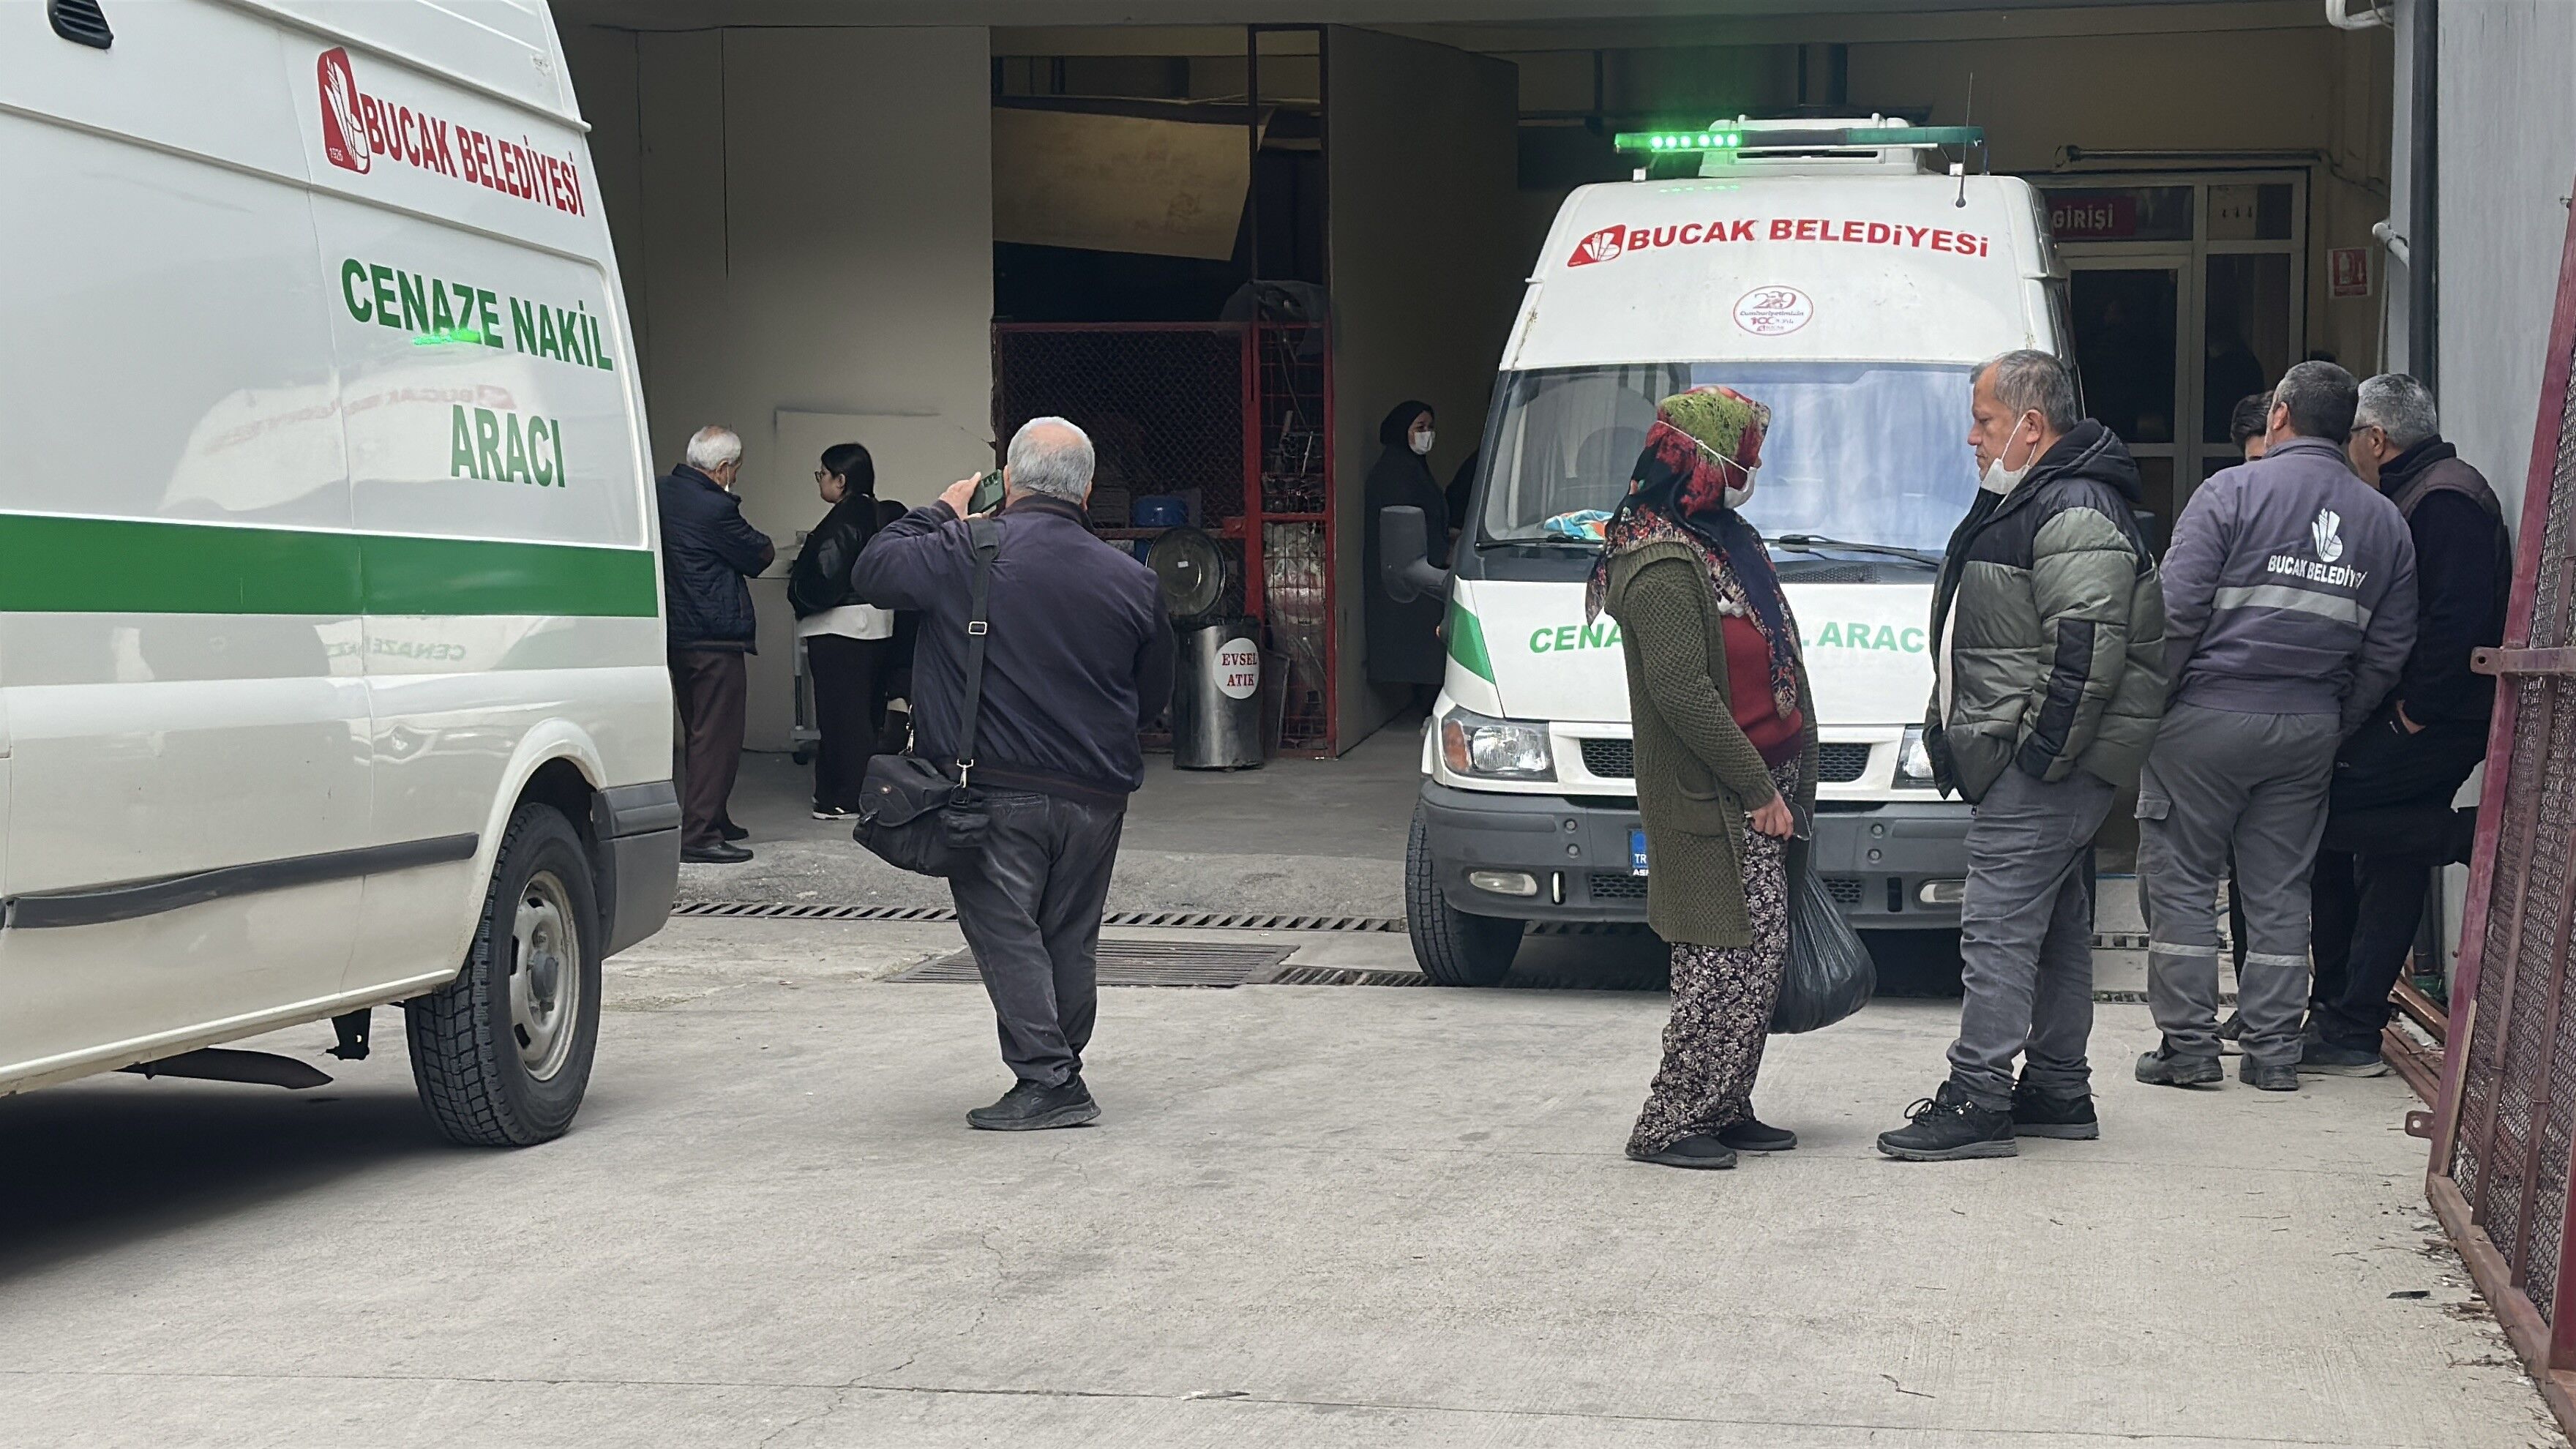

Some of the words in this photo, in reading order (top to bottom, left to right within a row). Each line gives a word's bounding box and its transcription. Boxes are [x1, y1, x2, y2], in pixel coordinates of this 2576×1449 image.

[360, 93, 457, 177] BUCAK
[455, 125, 585, 217] BELEDİYESİ
[1628, 220, 1756, 250] BUCAK
[342, 258, 503, 349] CENAZE
[509, 296, 613, 372] NAKİL
[451, 404, 566, 488] ARACI
[2267, 555, 2307, 578] BUCAK
[1221, 653, 1257, 666] EVSEL
[1227, 674, 1254, 686] ATIK
[1634, 853, 1647, 864] TR
